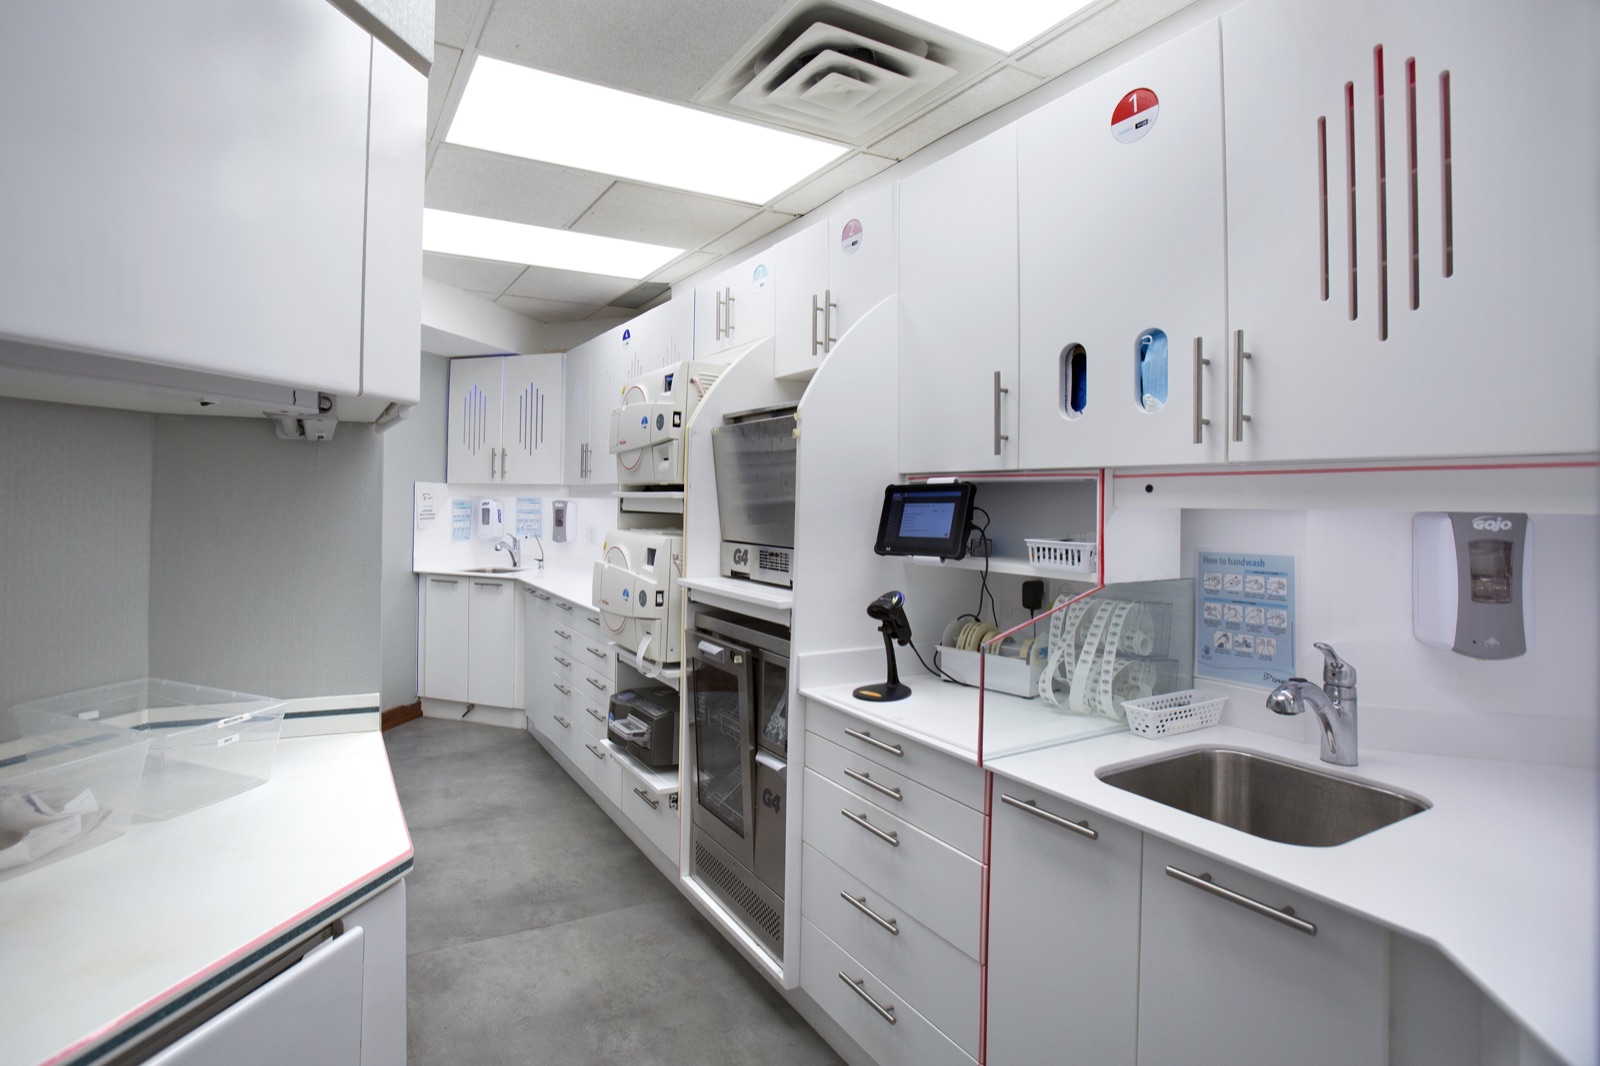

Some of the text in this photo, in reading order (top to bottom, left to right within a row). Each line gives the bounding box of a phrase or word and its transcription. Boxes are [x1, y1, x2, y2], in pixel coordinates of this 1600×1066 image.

[1128, 93, 1138, 113] 1
[733, 548, 748, 566] G4
[1203, 556, 1265, 568] How to handwash
[762, 788, 781, 814] G4
